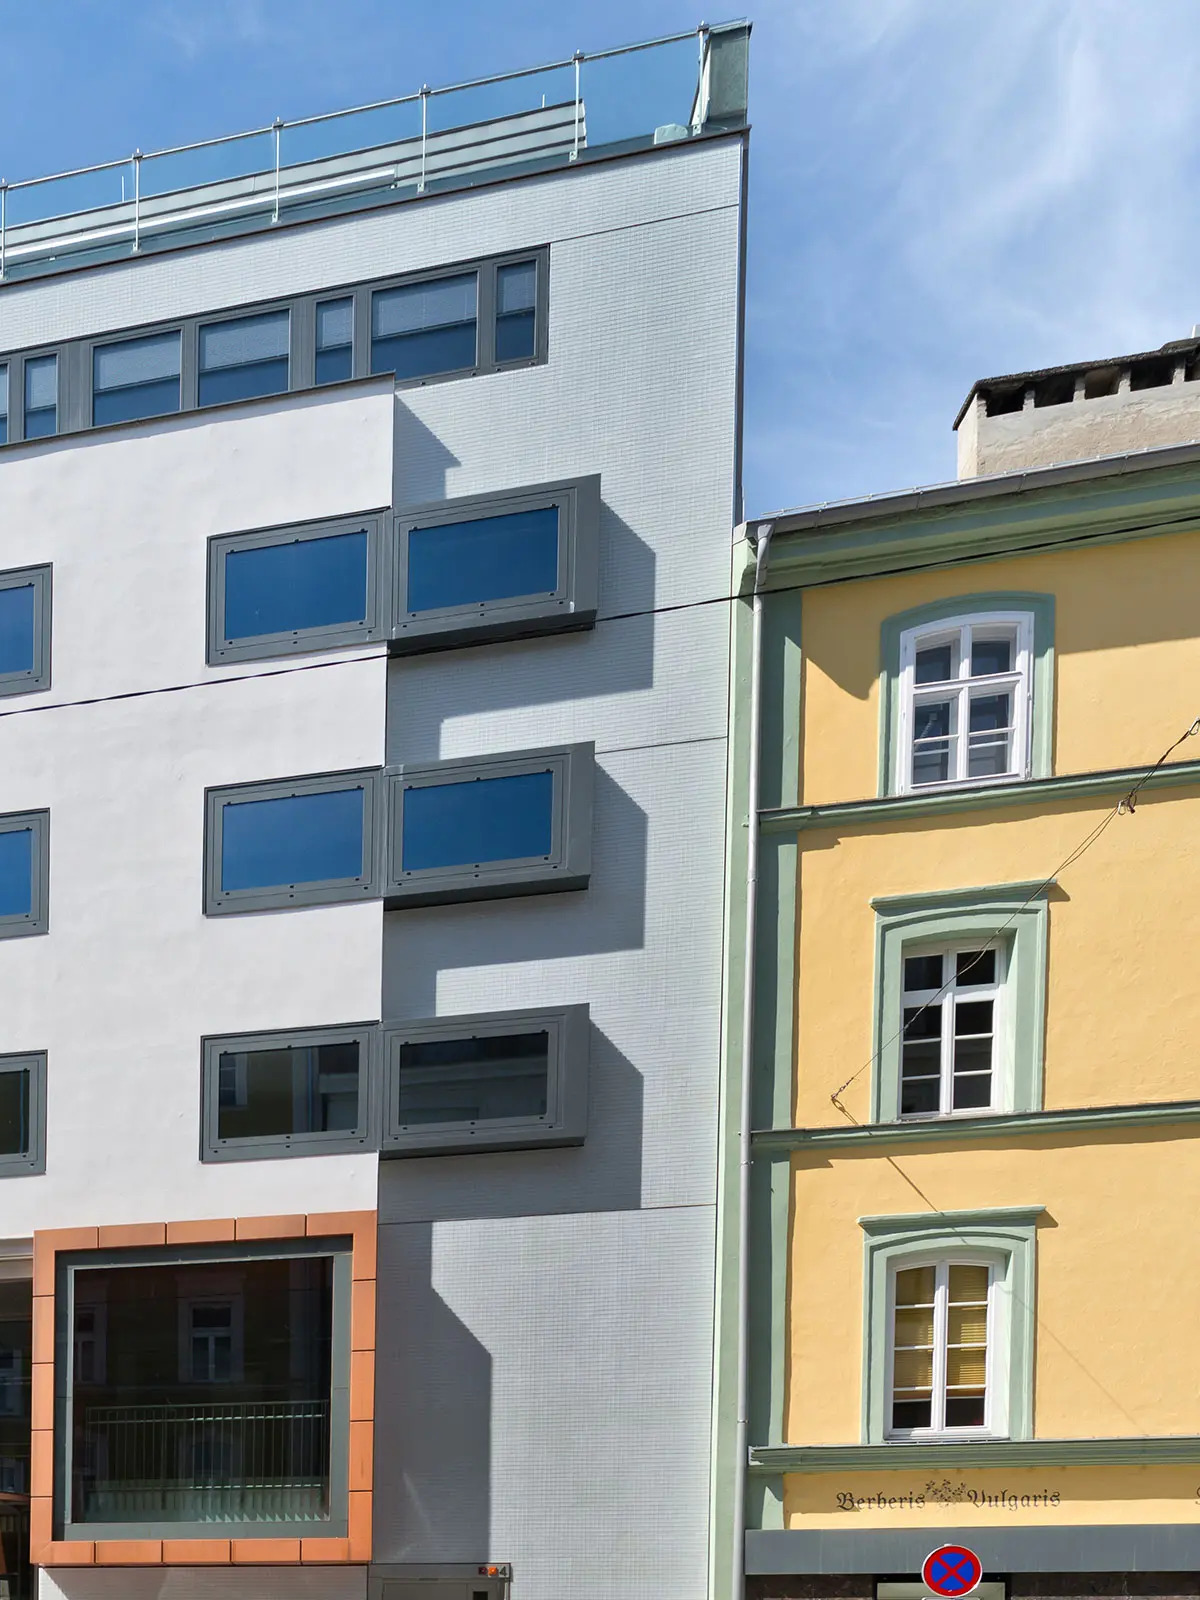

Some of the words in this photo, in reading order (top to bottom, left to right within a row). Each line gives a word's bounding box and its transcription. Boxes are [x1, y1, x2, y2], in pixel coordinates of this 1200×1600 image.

[836, 1490, 926, 1510] Berberis
[966, 1488, 1061, 1511] Vulgaris
[499, 1566, 508, 1577] 4
